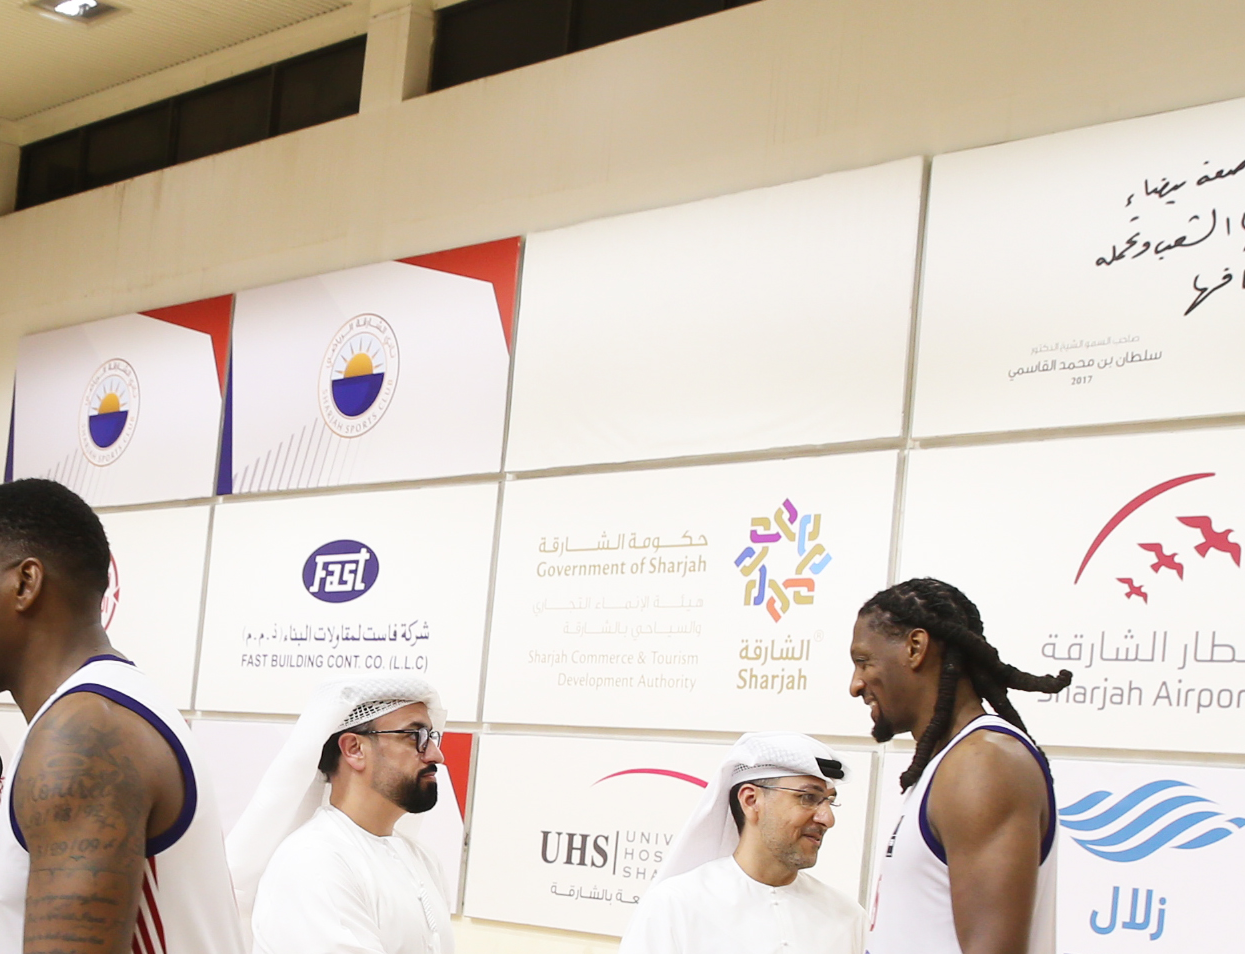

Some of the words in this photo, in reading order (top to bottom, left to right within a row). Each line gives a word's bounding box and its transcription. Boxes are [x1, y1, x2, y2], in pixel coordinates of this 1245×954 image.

[1058, 357, 1095, 371] محمد
[1096, 356, 1114, 370] بن
[1115, 349, 1163, 368] سلطان
[1007, 359, 1057, 381] القاسمي
[1070, 375, 1093, 386] 2017
[345, 413, 377, 434] SPORTS
[537, 531, 626, 557] الشارقة
[628, 530, 709, 551] حكومة
[536, 558, 627, 578] Government
[629, 556, 647, 575] of
[648, 554, 708, 578] Sharjah
[362, 623, 398, 642] فاست
[401, 619, 430, 647] شركة
[528, 650, 568, 667] Sharjah
[571, 650, 634, 665] Commerce
[637, 651, 647, 665] &
[651, 650, 699, 665] Tourism
[739, 634, 811, 666] الشارقة
[1041, 629, 1167, 668] الشارقة
[1178, 631, 1245, 669] طار
[241, 653, 268, 668] FAST
[270, 654, 324, 668] BUILDING
[327, 654, 361, 669] CONT.
[365, 655, 385, 670] CO.
[389, 655, 429, 673] (L.L.C)
[557, 672, 634, 691] Development
[636, 673, 697, 692] Authority
[736, 667, 808, 695] Sharjah
[1152, 678, 1245, 714] Airpor
[624, 829, 674, 846] UNIV
[540, 829, 610, 869] UHS
[623, 847, 664, 863] HOS
[550, 882, 613, 905] بالشارقة
[1090, 885, 1167, 941] زلال
